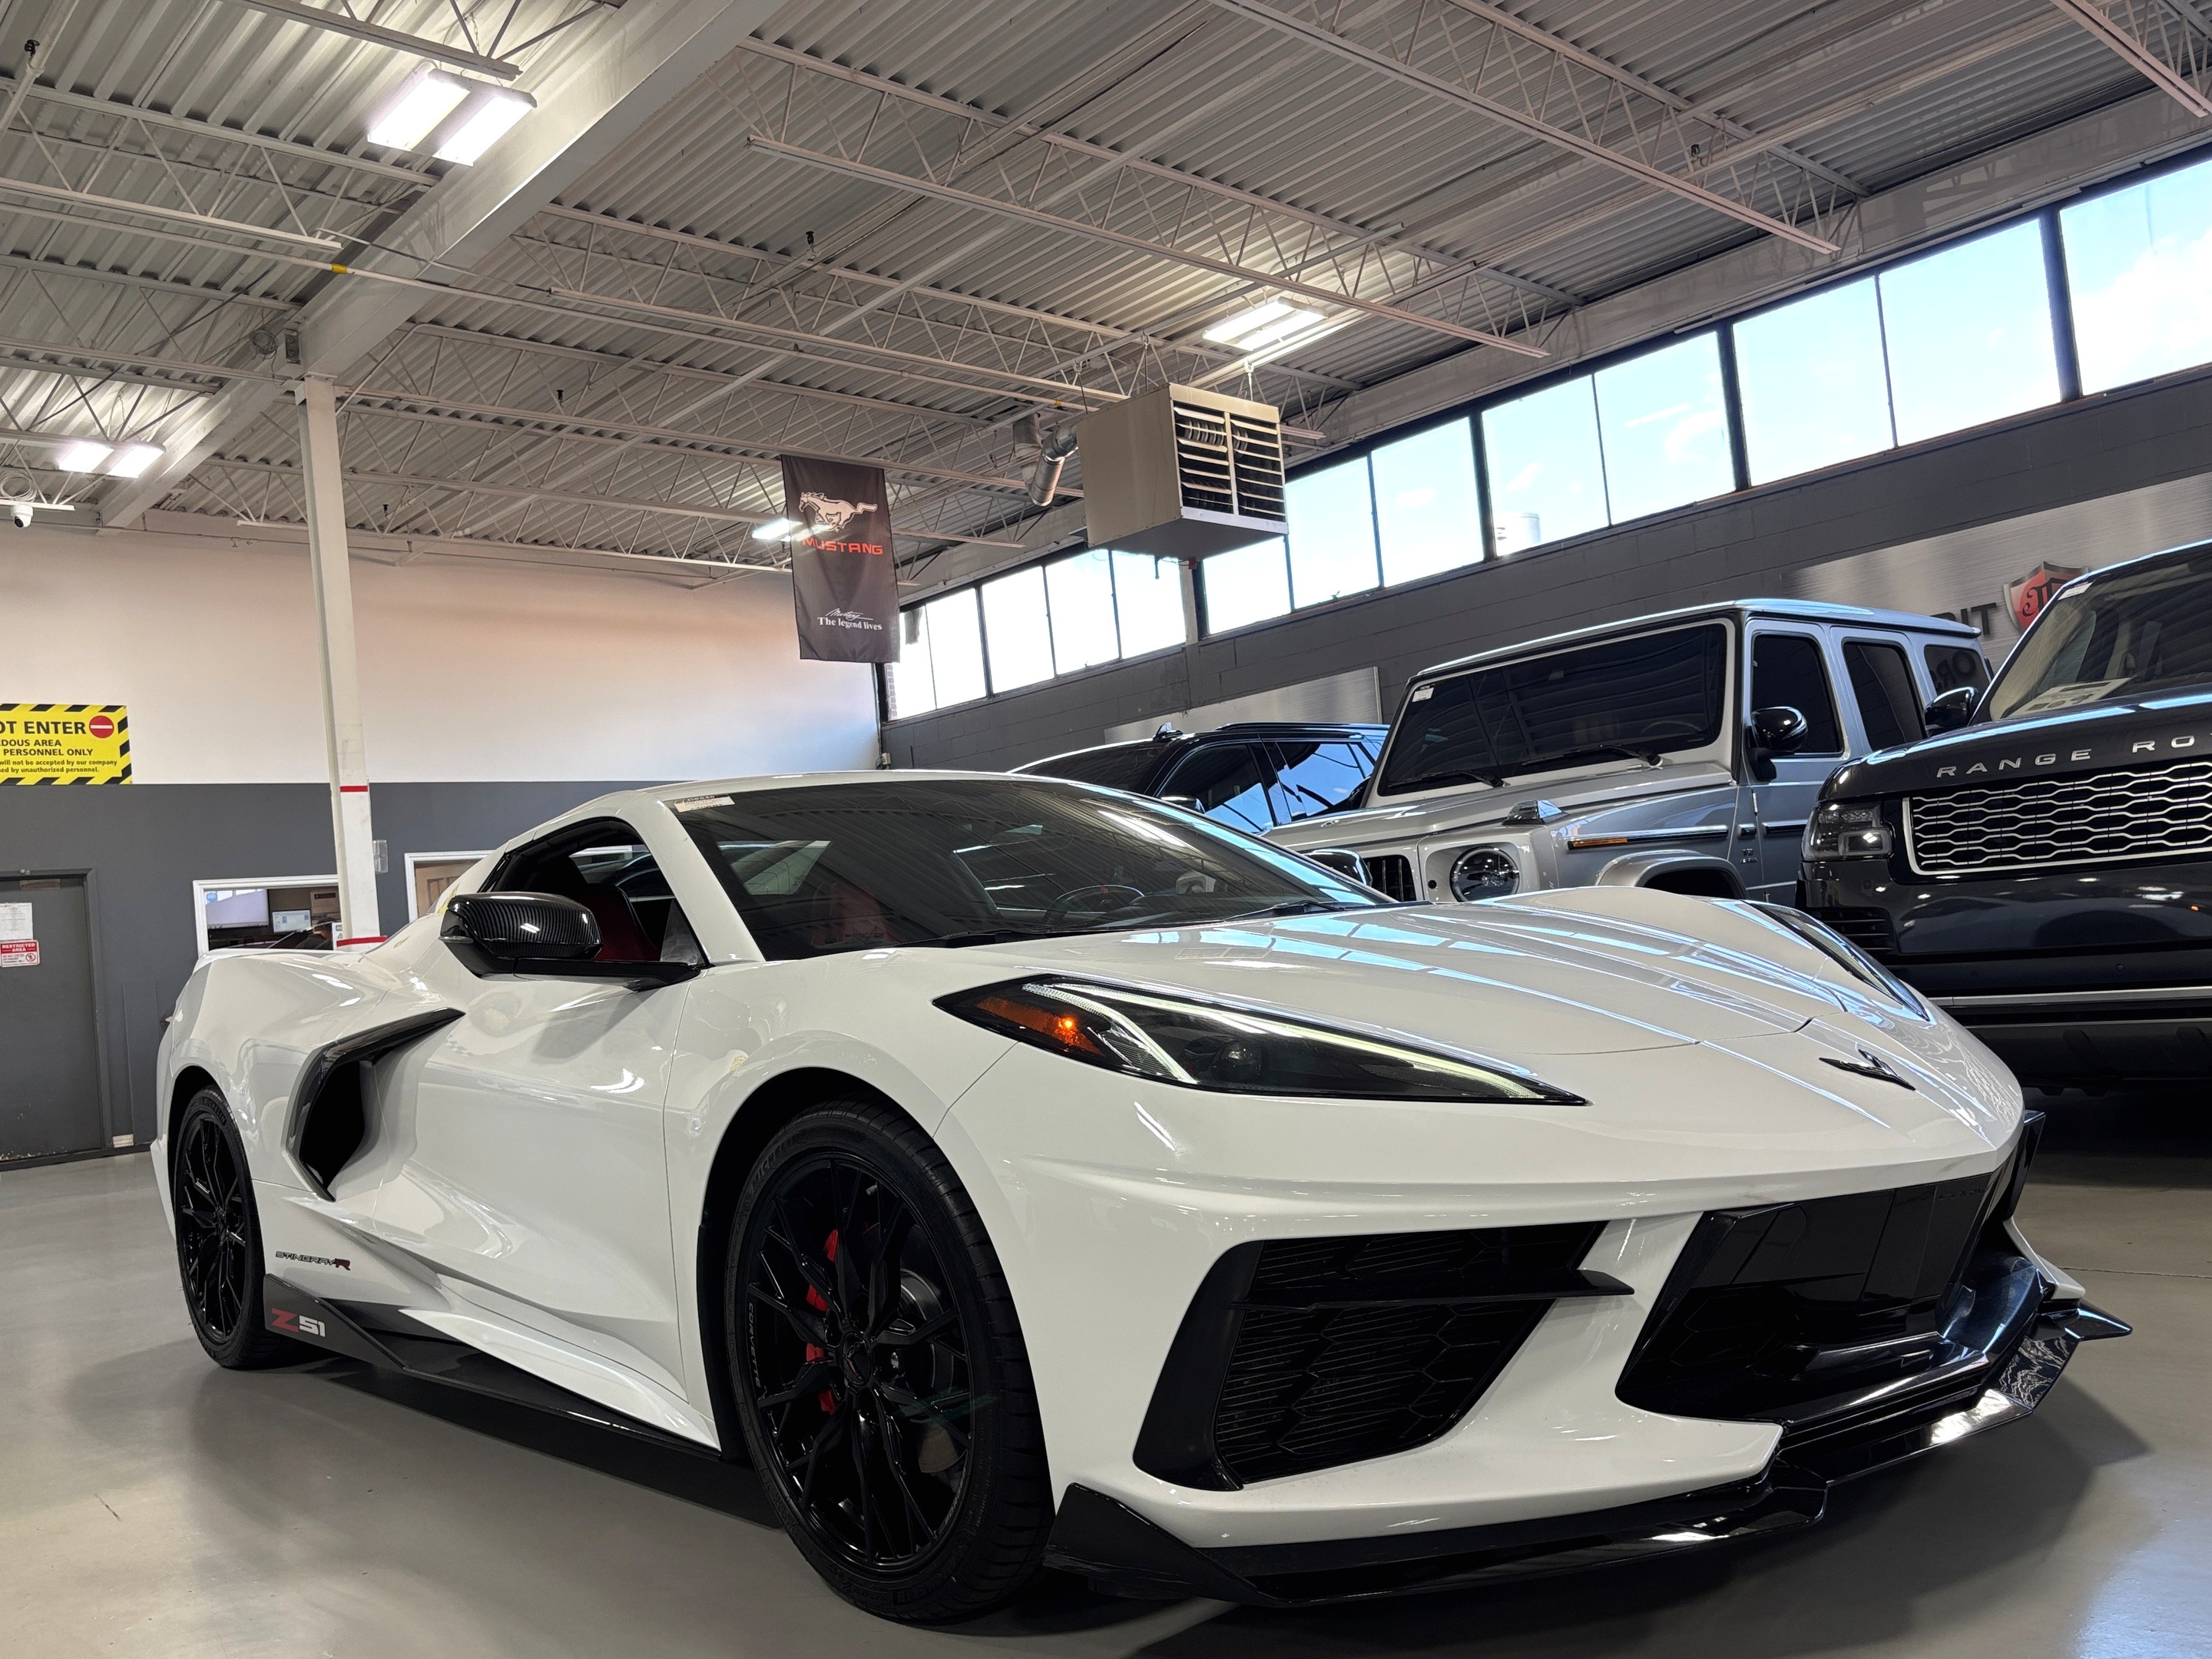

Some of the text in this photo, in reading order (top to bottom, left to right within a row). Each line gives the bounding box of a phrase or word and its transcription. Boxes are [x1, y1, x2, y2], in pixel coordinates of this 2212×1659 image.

[802, 538, 883, 555] MUSTANG
[817, 617, 882, 631] The legend lives
[24, 720, 87, 734] ENTER
[3, 748, 94, 757] PERSONNEL ONLY
[1936, 732, 2212, 778] RANGE RO
[272, 1307, 326, 1337] Z51
[749, 1302, 761, 1388] CORVETTE
